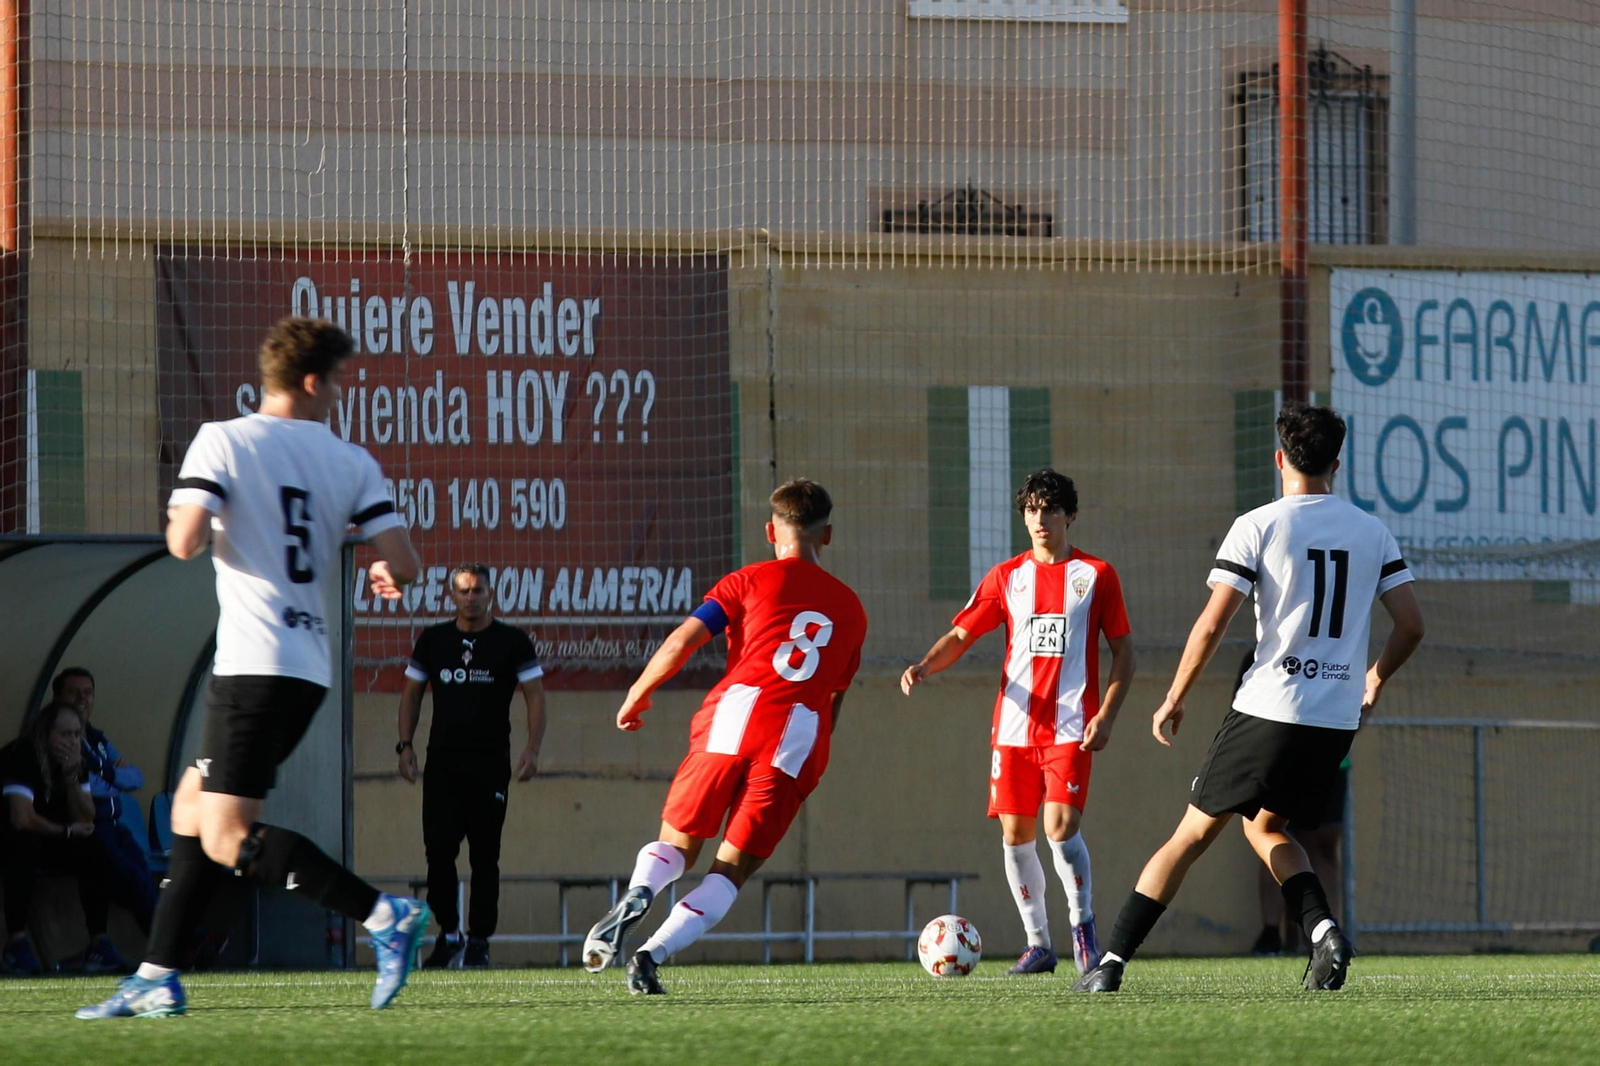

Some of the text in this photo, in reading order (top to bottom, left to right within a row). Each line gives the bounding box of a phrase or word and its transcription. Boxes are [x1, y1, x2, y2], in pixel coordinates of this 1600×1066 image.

[447, 280, 600, 356] Vender
[486, 368, 570, 446] HOY
[586, 368, 656, 444] ???
[1346, 413, 1596, 516] LOS PIN
[279, 486, 314, 584] 5
[448, 477, 500, 530] 140
[511, 477, 567, 530] 590
[549, 566, 693, 613] ALMERIA
[1306, 548, 1349, 639] 11
[557, 635, 621, 658] nosotros
[625, 638, 642, 657] es
[772, 611, 833, 682] 8
[1321, 662, 1350, 672] Fútbol
[991, 749, 1001, 780] 8
